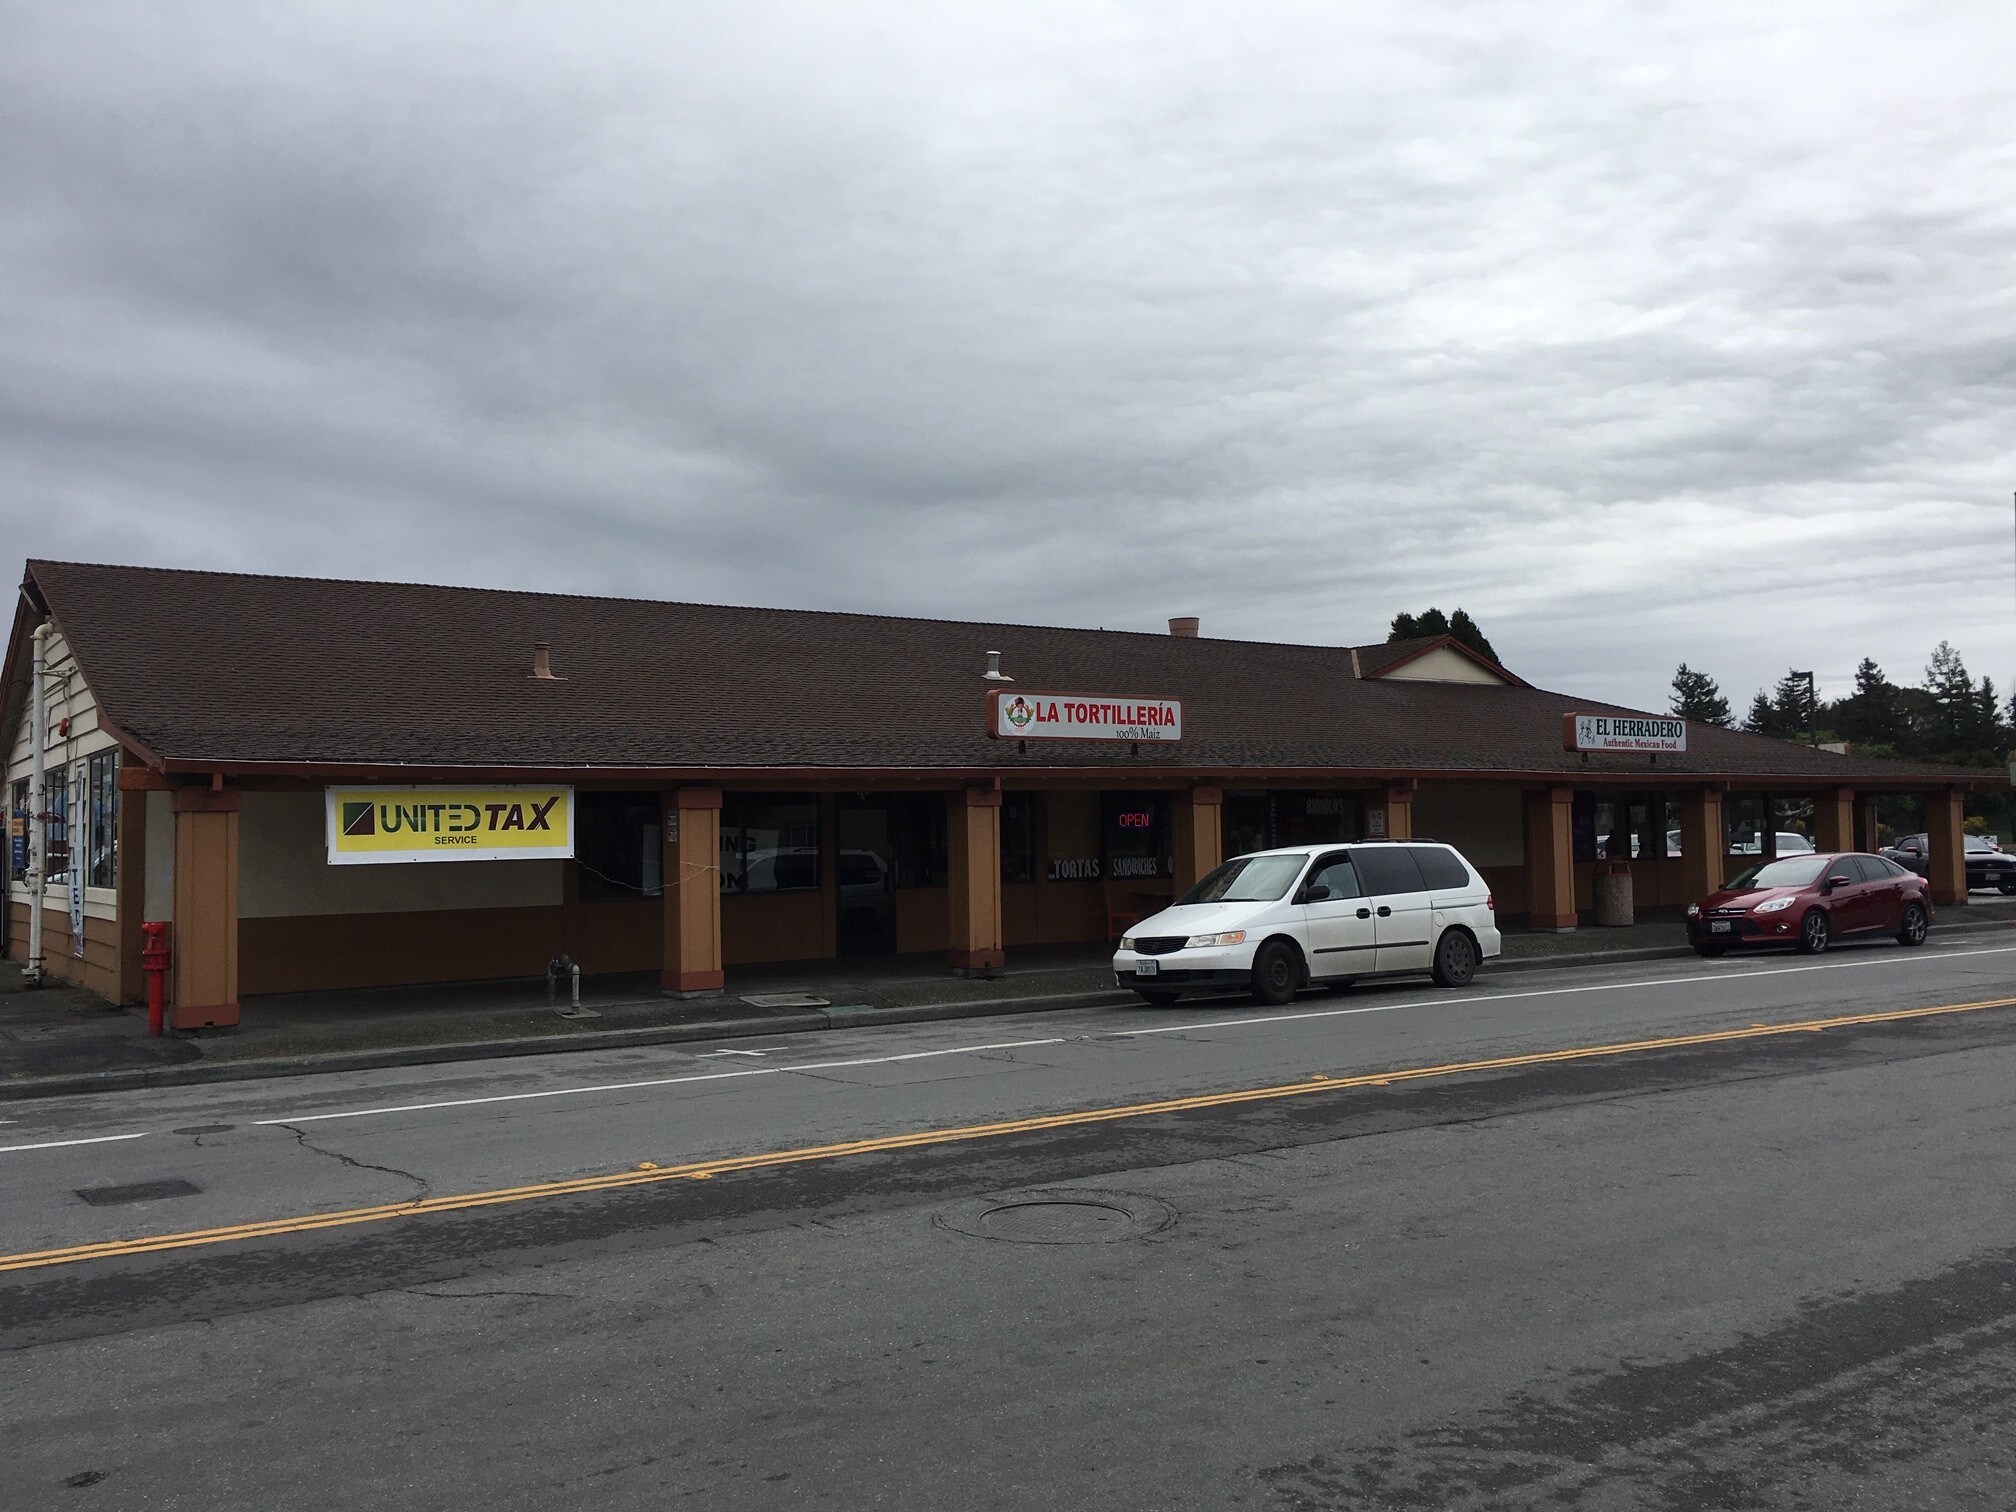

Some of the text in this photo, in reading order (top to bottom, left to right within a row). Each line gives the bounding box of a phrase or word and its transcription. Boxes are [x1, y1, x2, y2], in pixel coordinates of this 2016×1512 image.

[1036, 701, 1176, 726] LA TORTILLERÍA
[1116, 727, 1139, 739] 100%
[1596, 718, 1683, 738] EL HERRADERO
[1603, 738, 1677, 749] Authentic Mexican Food
[380, 796, 560, 833] UNITED TAX
[1119, 813, 1149, 827] OPEN
[434, 835, 478, 845] SERVICE
[720, 836, 757, 852] ING
[1053, 858, 1100, 879] TORTAS
[1113, 857, 1157, 876] SANDWICHES
